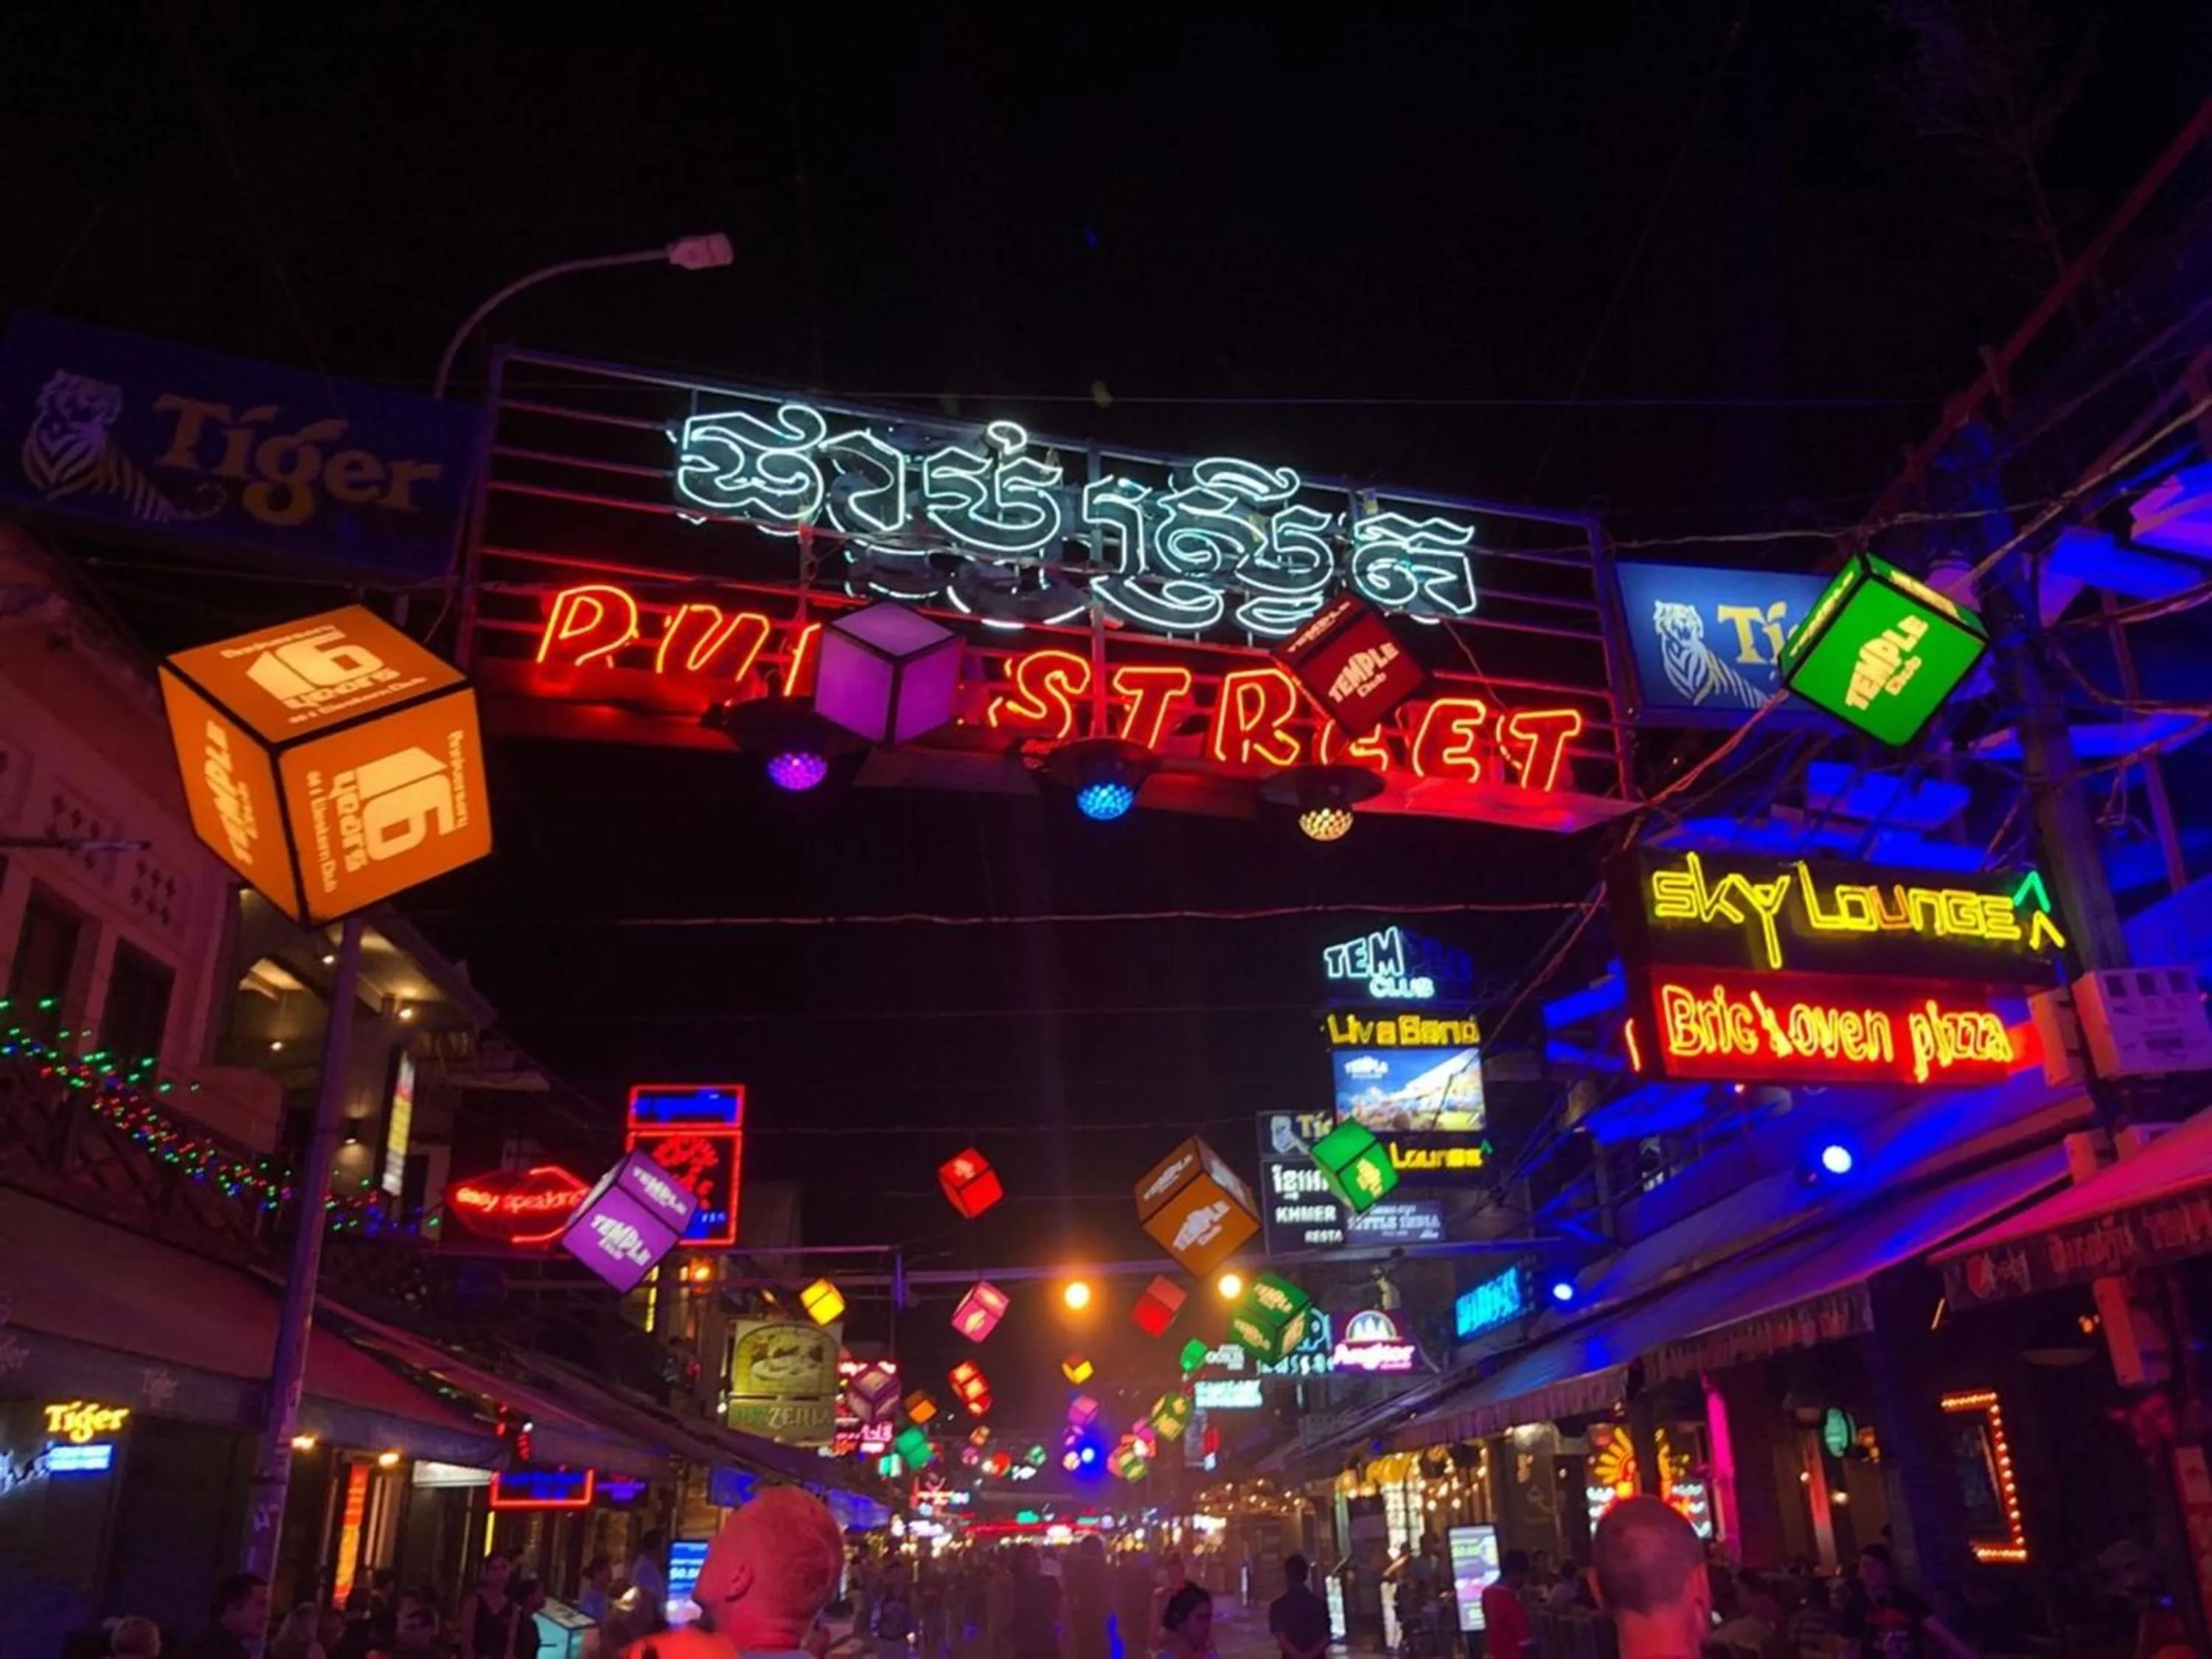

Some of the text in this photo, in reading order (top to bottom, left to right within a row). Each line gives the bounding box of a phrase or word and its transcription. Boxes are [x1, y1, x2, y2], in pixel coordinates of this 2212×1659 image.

[153, 394, 442, 526] Tiger
[246, 629, 384, 701] 16
[536, 585, 821, 697] PU
[1329, 642, 1399, 703] TEMPLE
[1845, 614, 1929, 711] TEMPLE
[329, 770, 369, 873] years
[356, 746, 456, 861] 16
[1790, 1003, 1894, 1063] oven
[1910, 999, 2014, 1084] pizza
[591, 1214, 652, 1267] TEMPLE
[1276, 1206, 1337, 1223] KHMER
[44, 1400, 131, 1444] Tiger
